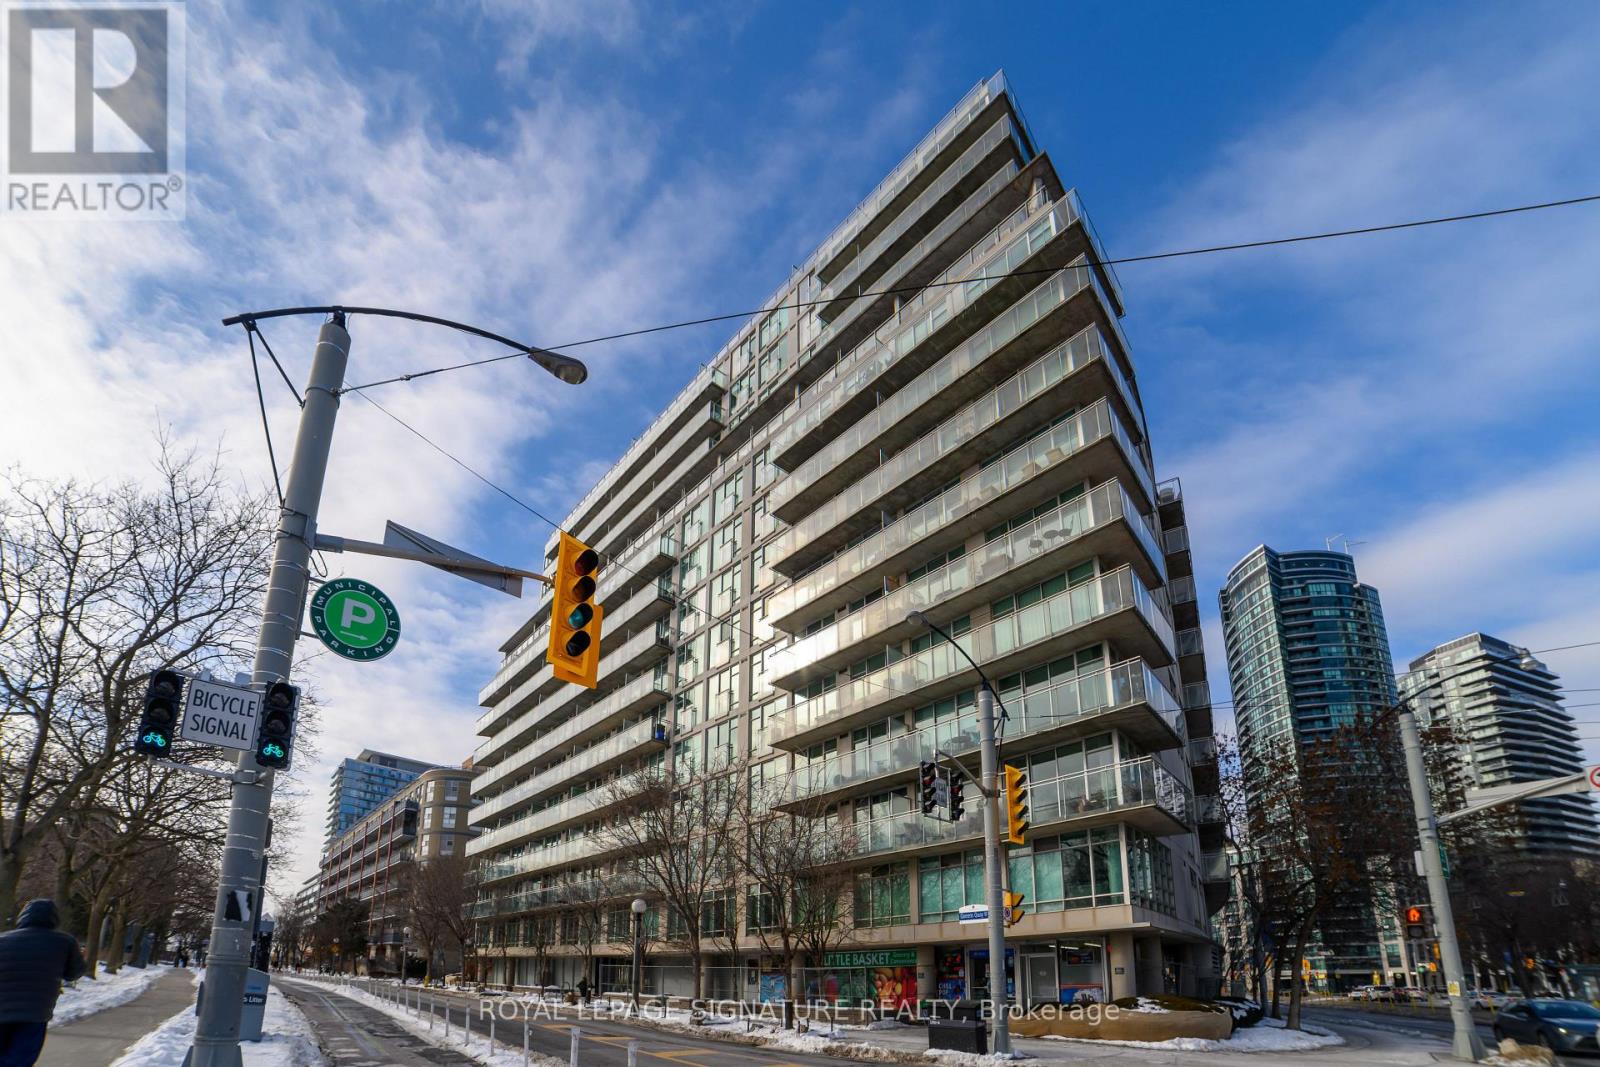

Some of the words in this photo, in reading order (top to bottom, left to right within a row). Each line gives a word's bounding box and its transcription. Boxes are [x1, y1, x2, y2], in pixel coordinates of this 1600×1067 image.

[317, 582, 396, 626] MUNICIPAL
[341, 598, 376, 628] P
[314, 615, 394, 657] PARKING
[193, 688, 257, 718] BICYCLE
[190, 713, 248, 741] SIGNAL
[853, 952, 890, 966] BASKET
